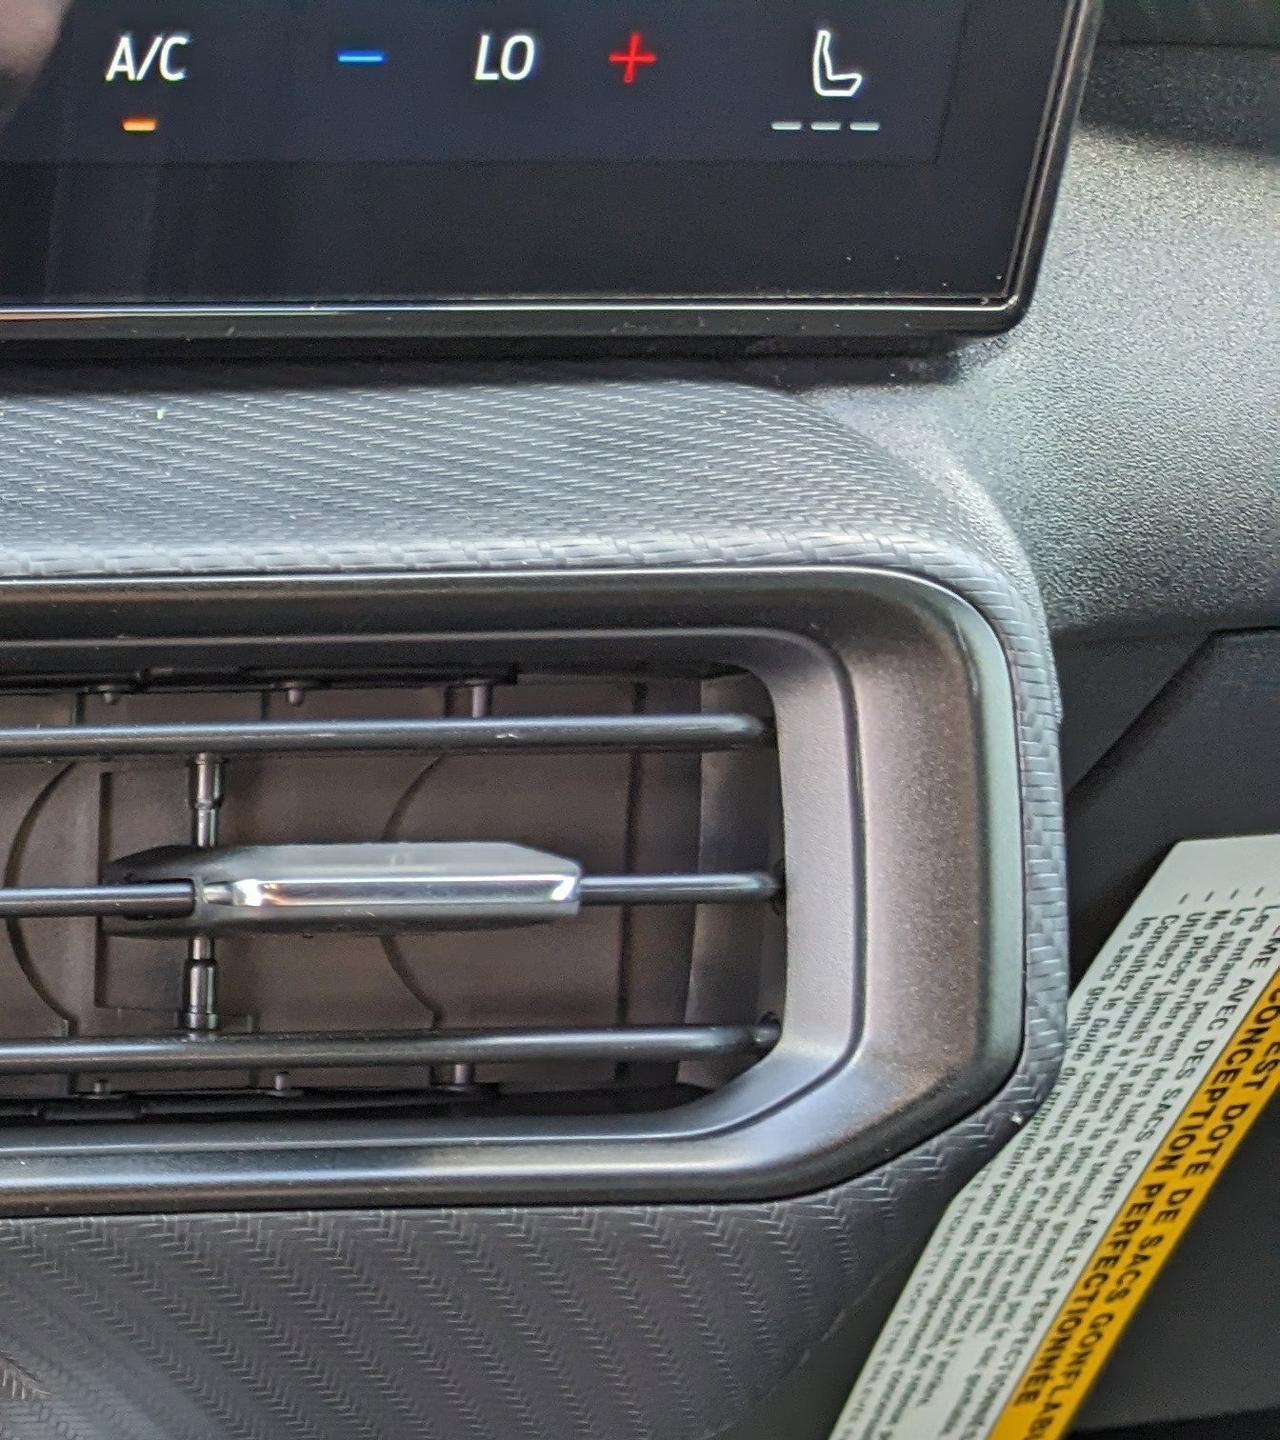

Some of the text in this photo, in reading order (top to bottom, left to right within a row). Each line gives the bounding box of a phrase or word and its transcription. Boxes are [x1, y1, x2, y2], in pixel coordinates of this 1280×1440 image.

[106, 35, 189, 81] A/C
[475, 35, 535, 80] LO
[1105, 1235, 1163, 1303] SACS
